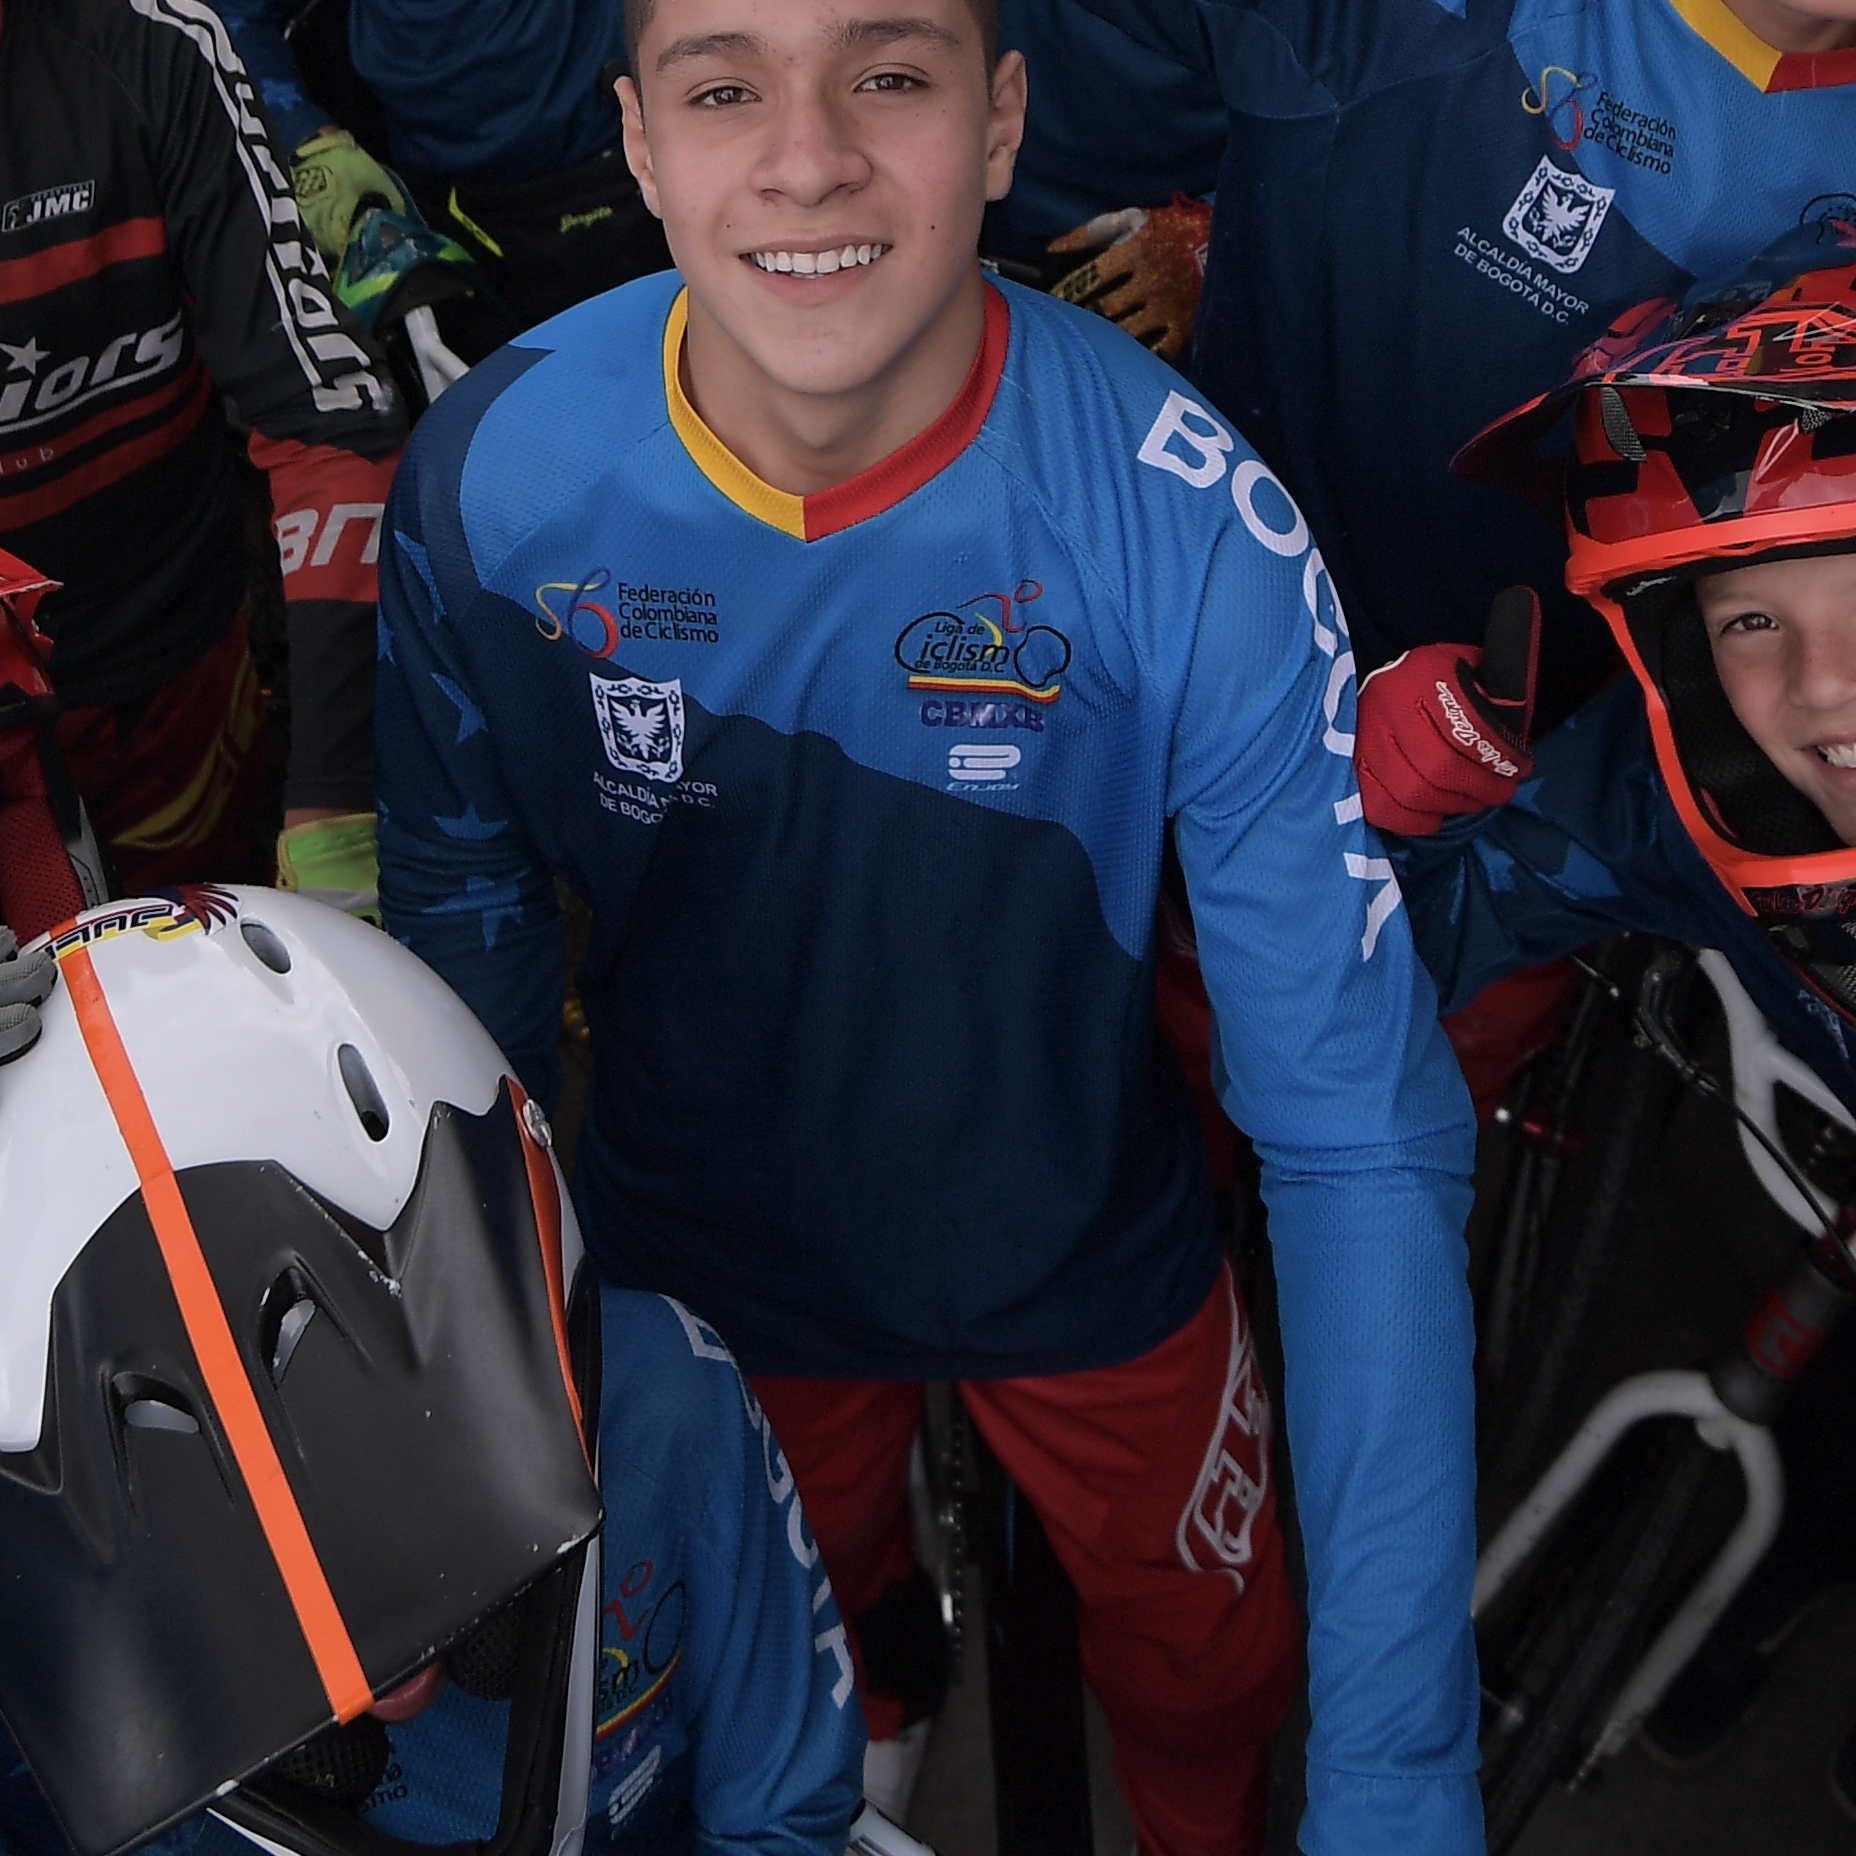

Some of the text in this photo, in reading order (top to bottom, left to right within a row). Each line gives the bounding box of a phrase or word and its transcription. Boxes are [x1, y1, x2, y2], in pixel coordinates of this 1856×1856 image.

[1590, 108, 1675, 158] Colombiana
[1596, 91, 1678, 141] Federación
[1583, 124, 1672, 176] de Ciclismo
[26, 190, 90, 224] JMC
[1454, 243, 1571, 326] DE BOGOTÁ D.C.
[1457, 226, 1590, 315] ALCALDÍA MAYOR
[618, 582, 717, 607] Federación
[618, 602, 718, 626] Colombiana
[621, 620, 720, 644] de Ciclismo
[967, 623, 986, 636] de
[593, 770, 660, 809] ALCALDÍA
[599, 792, 618, 814] DE
